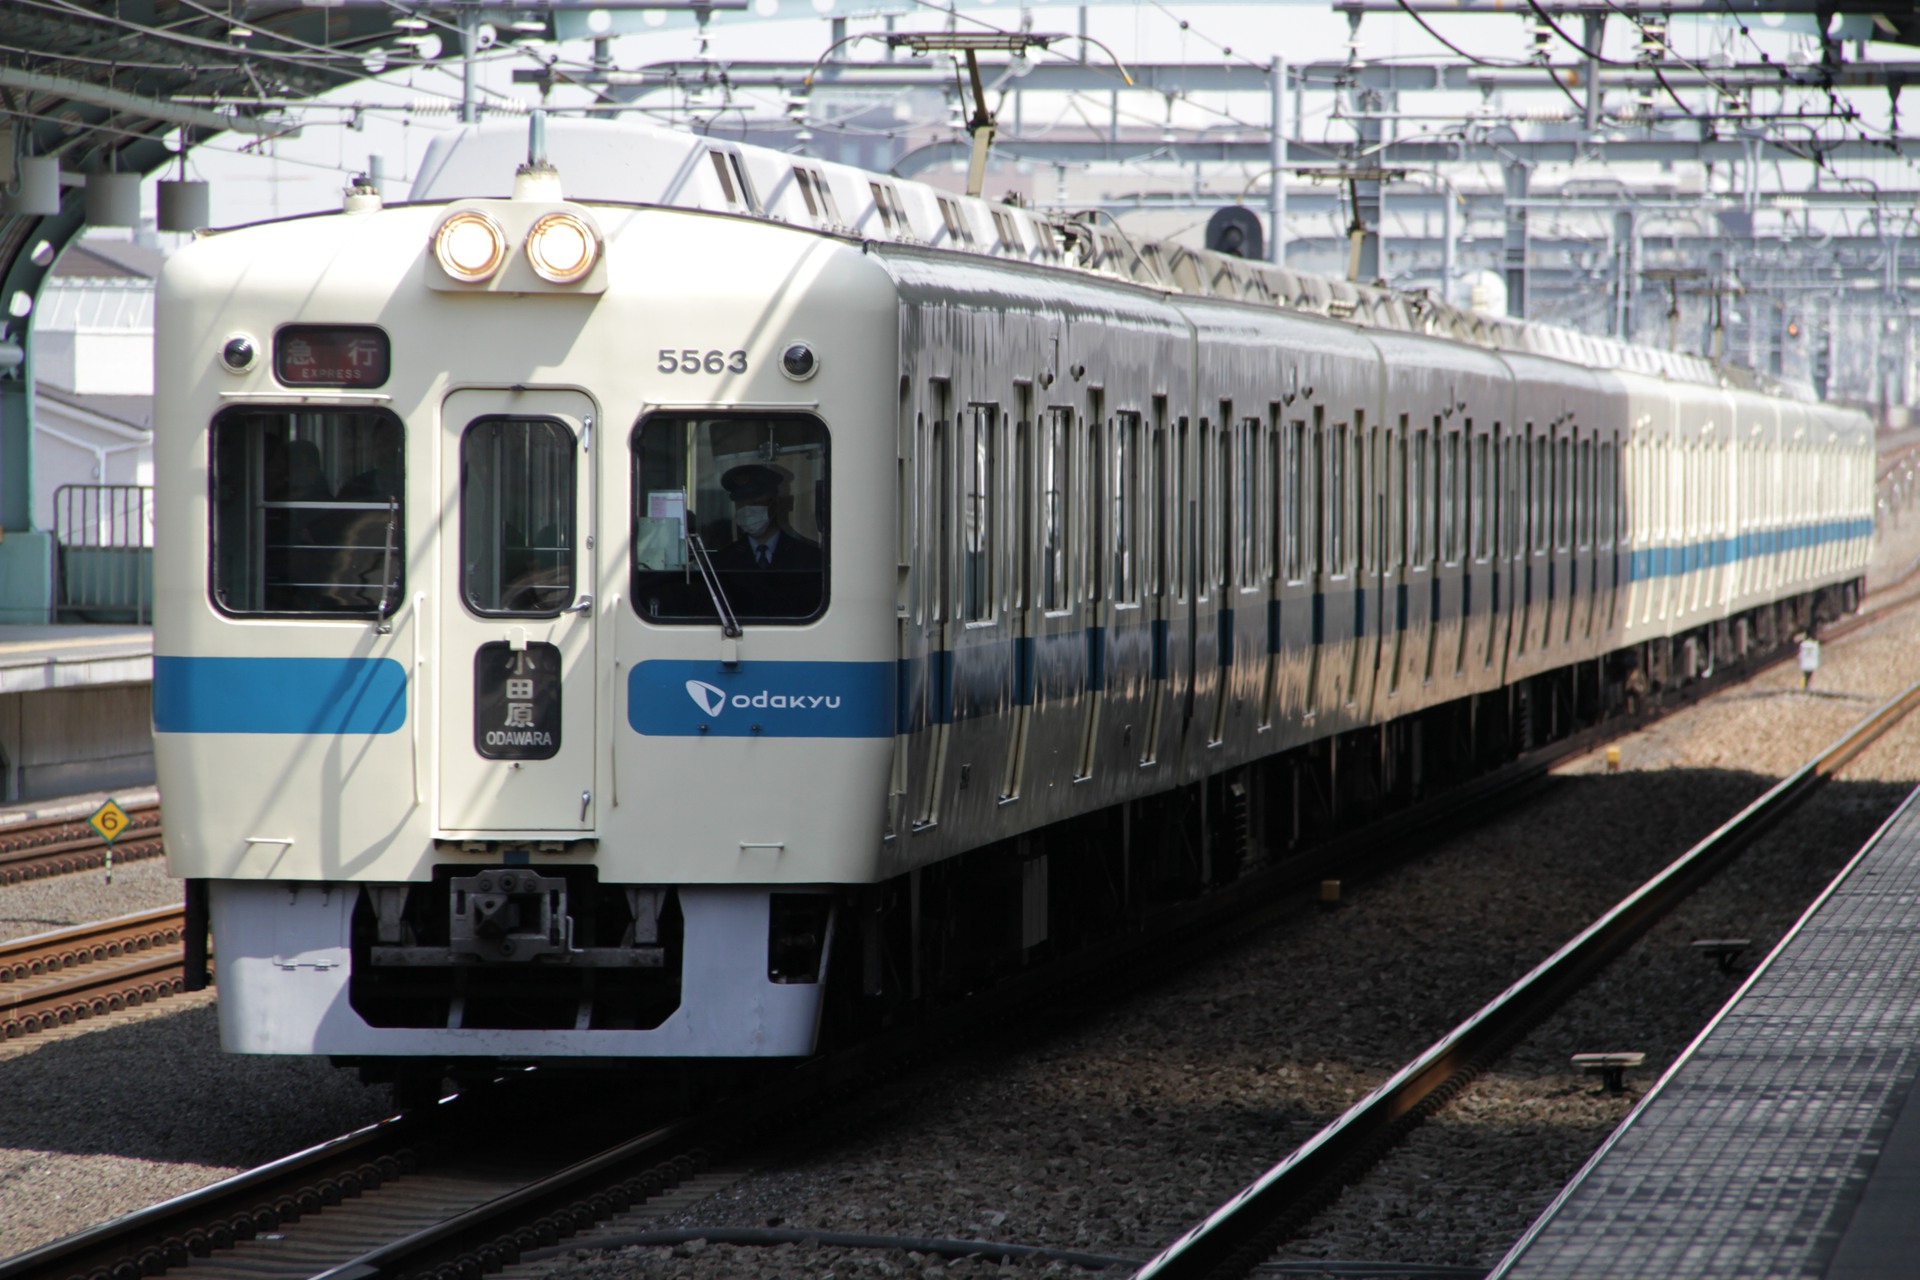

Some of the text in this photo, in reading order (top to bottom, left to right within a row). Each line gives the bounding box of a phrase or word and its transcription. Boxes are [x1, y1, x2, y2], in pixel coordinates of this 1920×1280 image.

[286, 339, 378, 366] 急行
[657, 349, 748, 375] 5563
[301, 368, 361, 379] EXPRESS
[504, 650, 535, 728] 小田原
[486, 731, 552, 746] ODAWARA
[101, 811, 118, 831] 6
